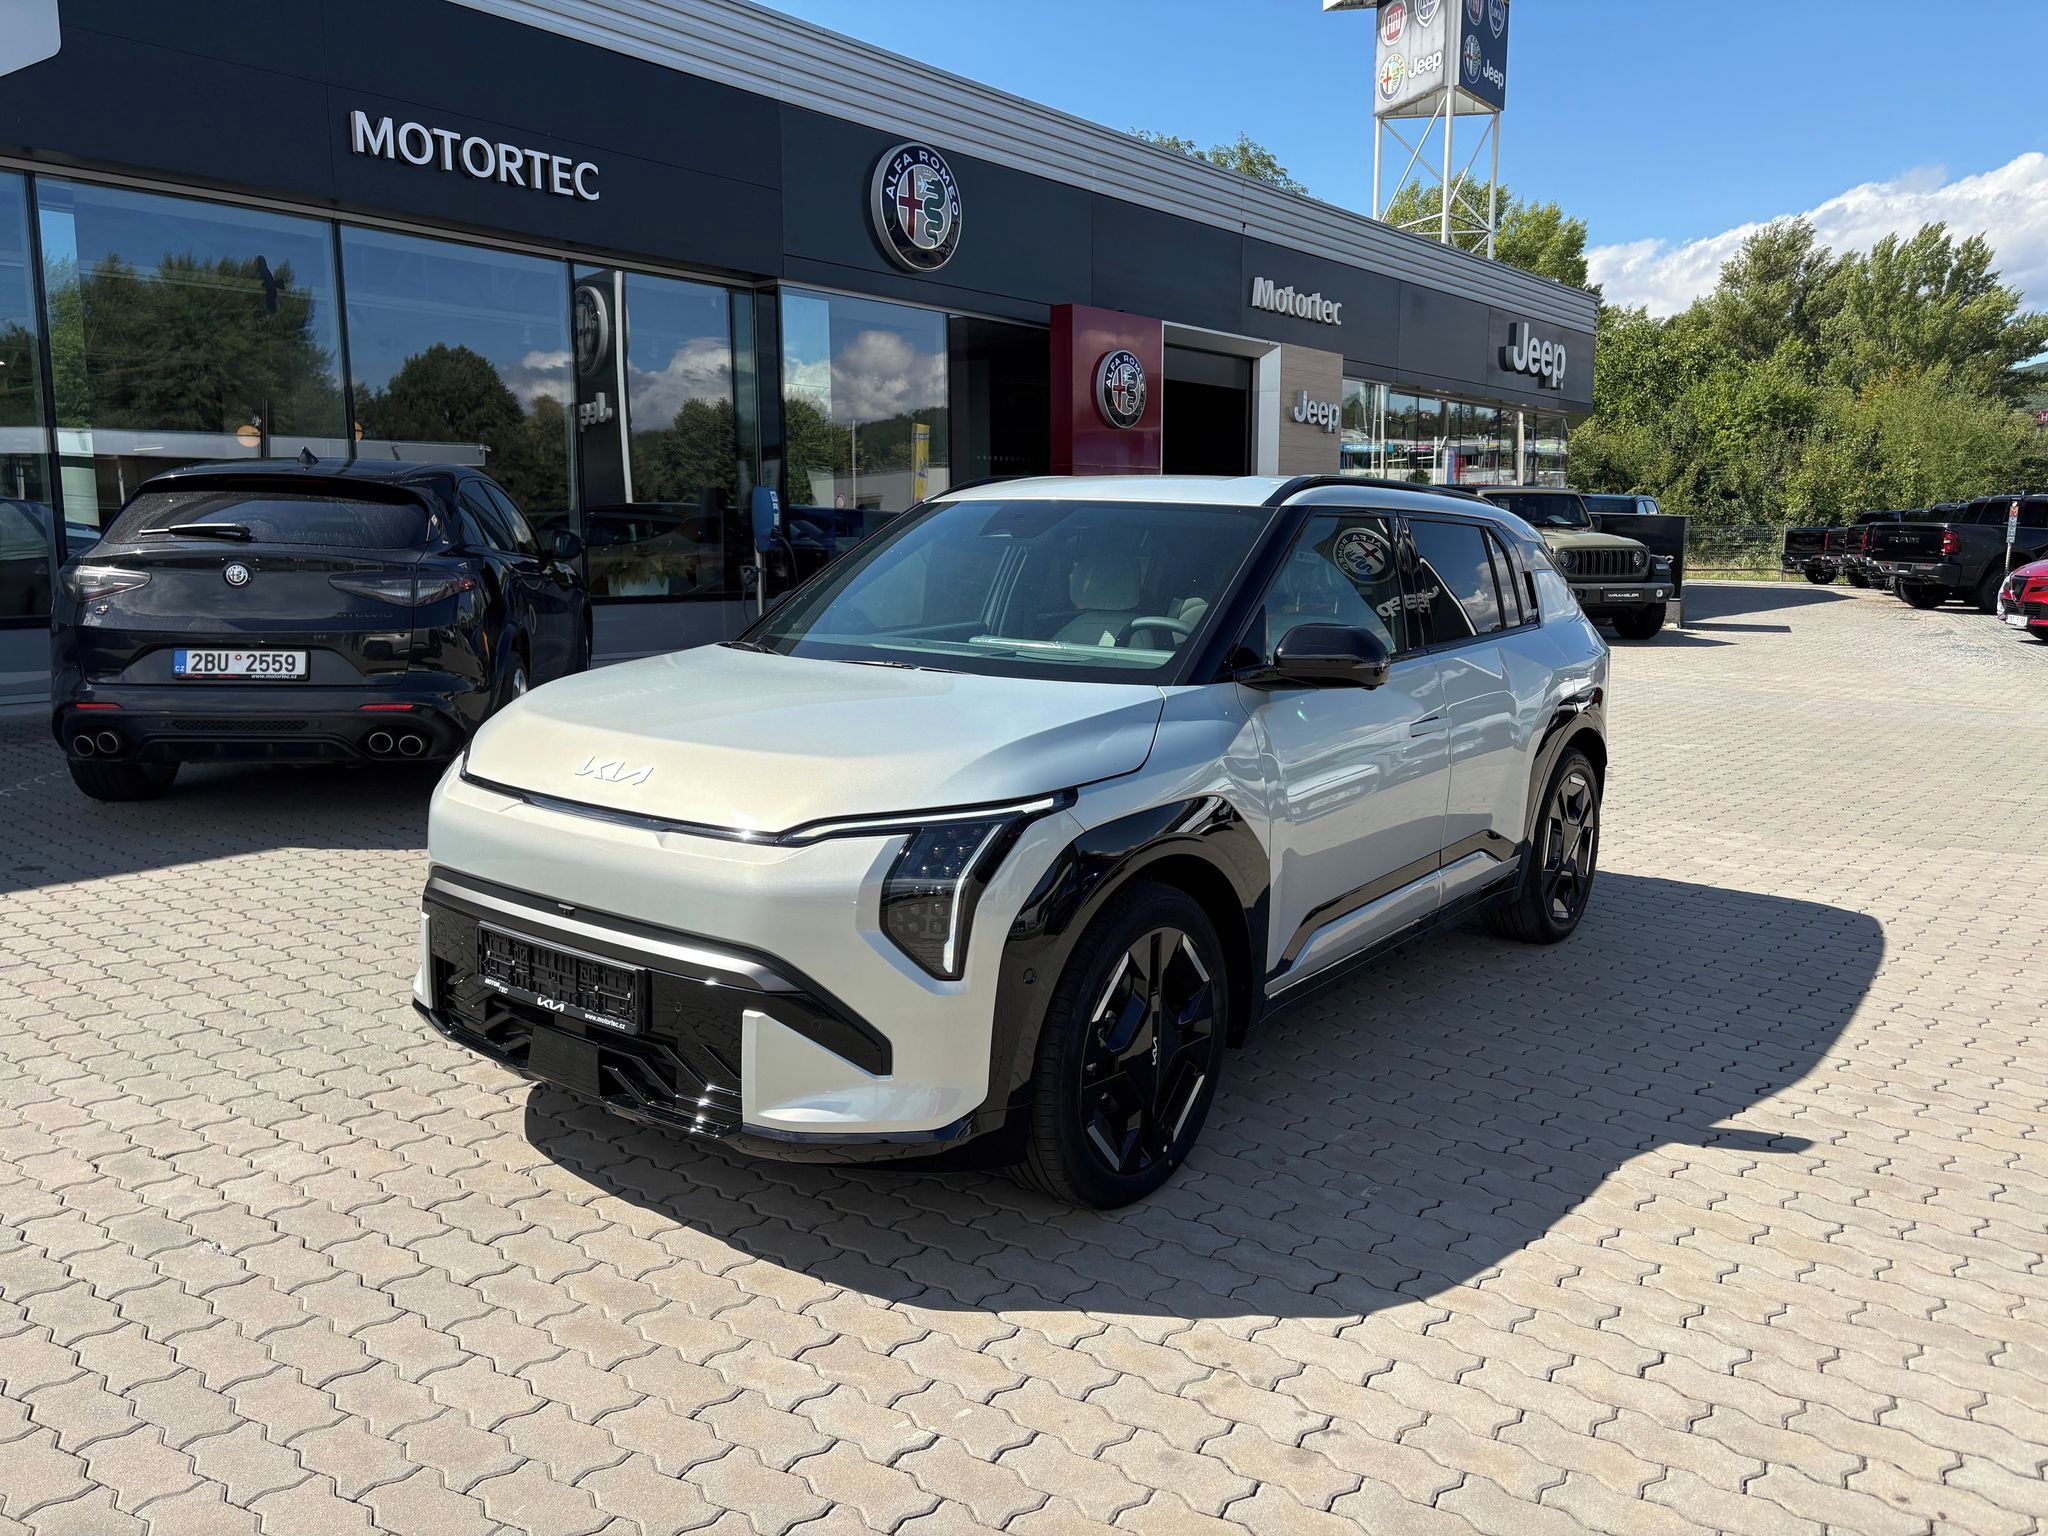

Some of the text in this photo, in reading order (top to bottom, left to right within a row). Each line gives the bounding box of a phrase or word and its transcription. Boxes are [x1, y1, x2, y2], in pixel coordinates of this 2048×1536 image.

[1386, 9, 1402, 35] FIAT
[1408, 50, 1442, 79] Jeep
[1482, 59, 1504, 90] Jeep
[351, 110, 600, 200] MOTORTEC
[885, 150, 960, 216] ALFA ROMEO
[1252, 276, 1342, 325] Motortec
[1512, 322, 1566, 389] Jeep
[1105, 354, 1145, 392] ALFA ROMEO
[1294, 390, 1340, 433] Jeep
[1889, 536, 1920, 544] RAM
[190, 653, 297, 673] 2BU 2559
[537, 996, 565, 1013] KIA
[584, 1012, 626, 1030] www.motortec.cz
